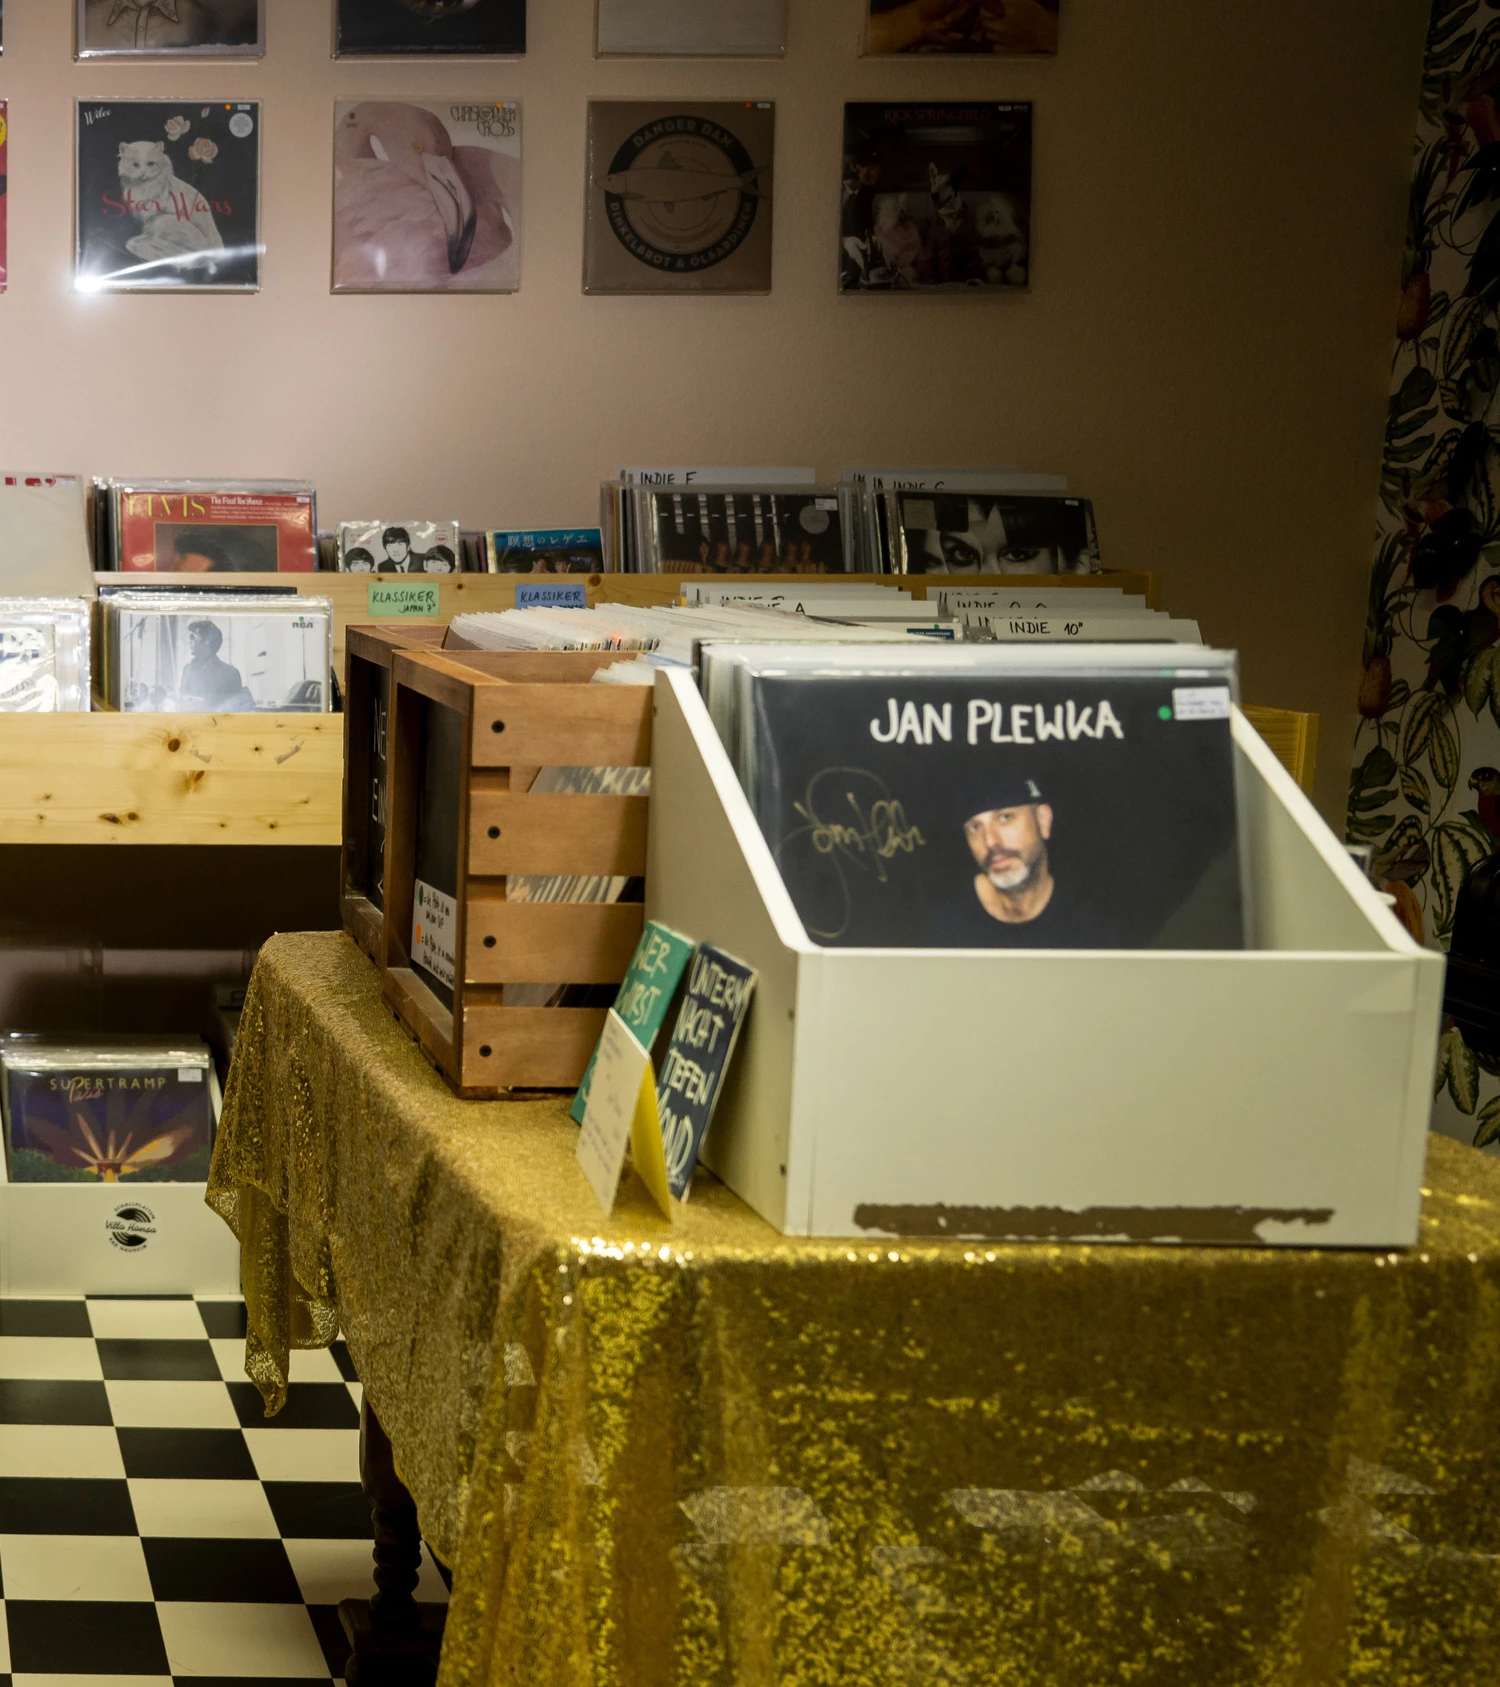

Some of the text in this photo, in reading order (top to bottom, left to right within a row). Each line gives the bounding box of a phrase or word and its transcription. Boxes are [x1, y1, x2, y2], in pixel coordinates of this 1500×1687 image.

[84, 106, 112, 126] Wilco
[884, 108, 992, 124] RICK SPRINGFIELD
[633, 119, 697, 148] DANGER
[701, 123, 734, 148] DAN
[102, 188, 233, 222] Star Wars
[610, 201, 672, 267] DINKELBROT
[640, 471, 697, 485] INDIE F
[128, 495, 206, 517] ELVIS
[372, 590, 435, 604] KLASSIKER
[520, 590, 582, 603] KLASSIKER
[398, 604, 424, 613] JAPAN
[1009, 621, 1083, 635] INDIE 10"
[870, 698, 1125, 745] JAN PLEWKA
[50, 1076, 166, 1090] SUPERTRAMP
[105, 1219, 157, 1233] Villa Hansa
